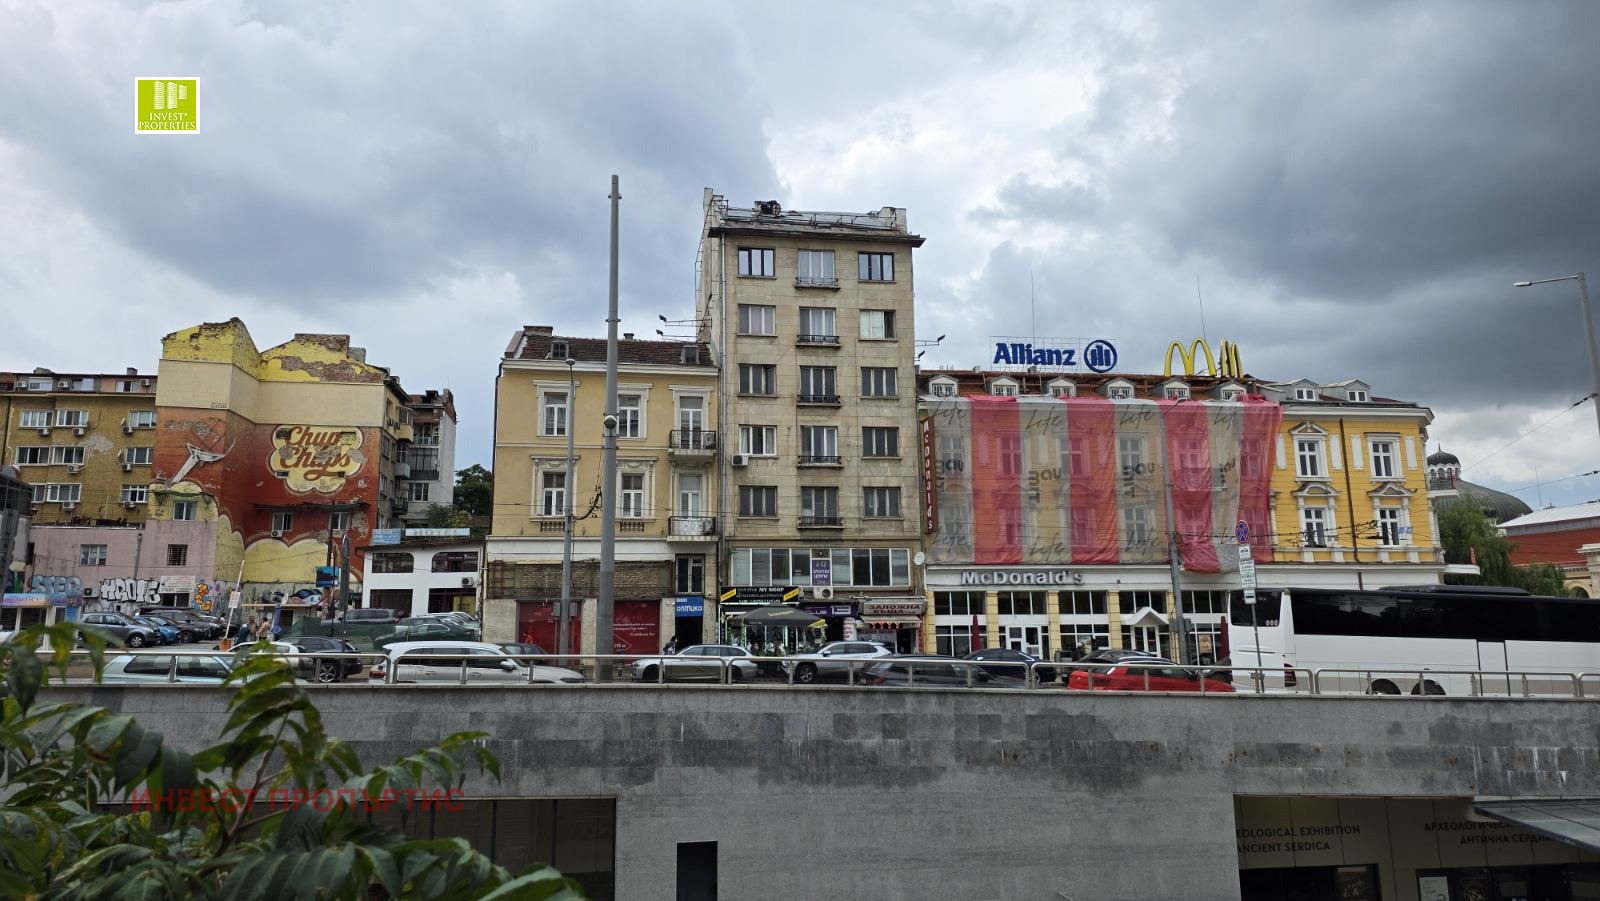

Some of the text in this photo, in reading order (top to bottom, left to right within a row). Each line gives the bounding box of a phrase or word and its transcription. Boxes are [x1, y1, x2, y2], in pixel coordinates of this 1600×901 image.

[993, 343, 1076, 366] Allianz
[961, 571, 1084, 586] McDonald's
[830, 604, 852, 616] 13
[1300, 825, 1361, 837] EXHIBITION
[1460, 834, 1510, 845] АНТИЧНА
[1285, 841, 1331, 852] SERDICA
